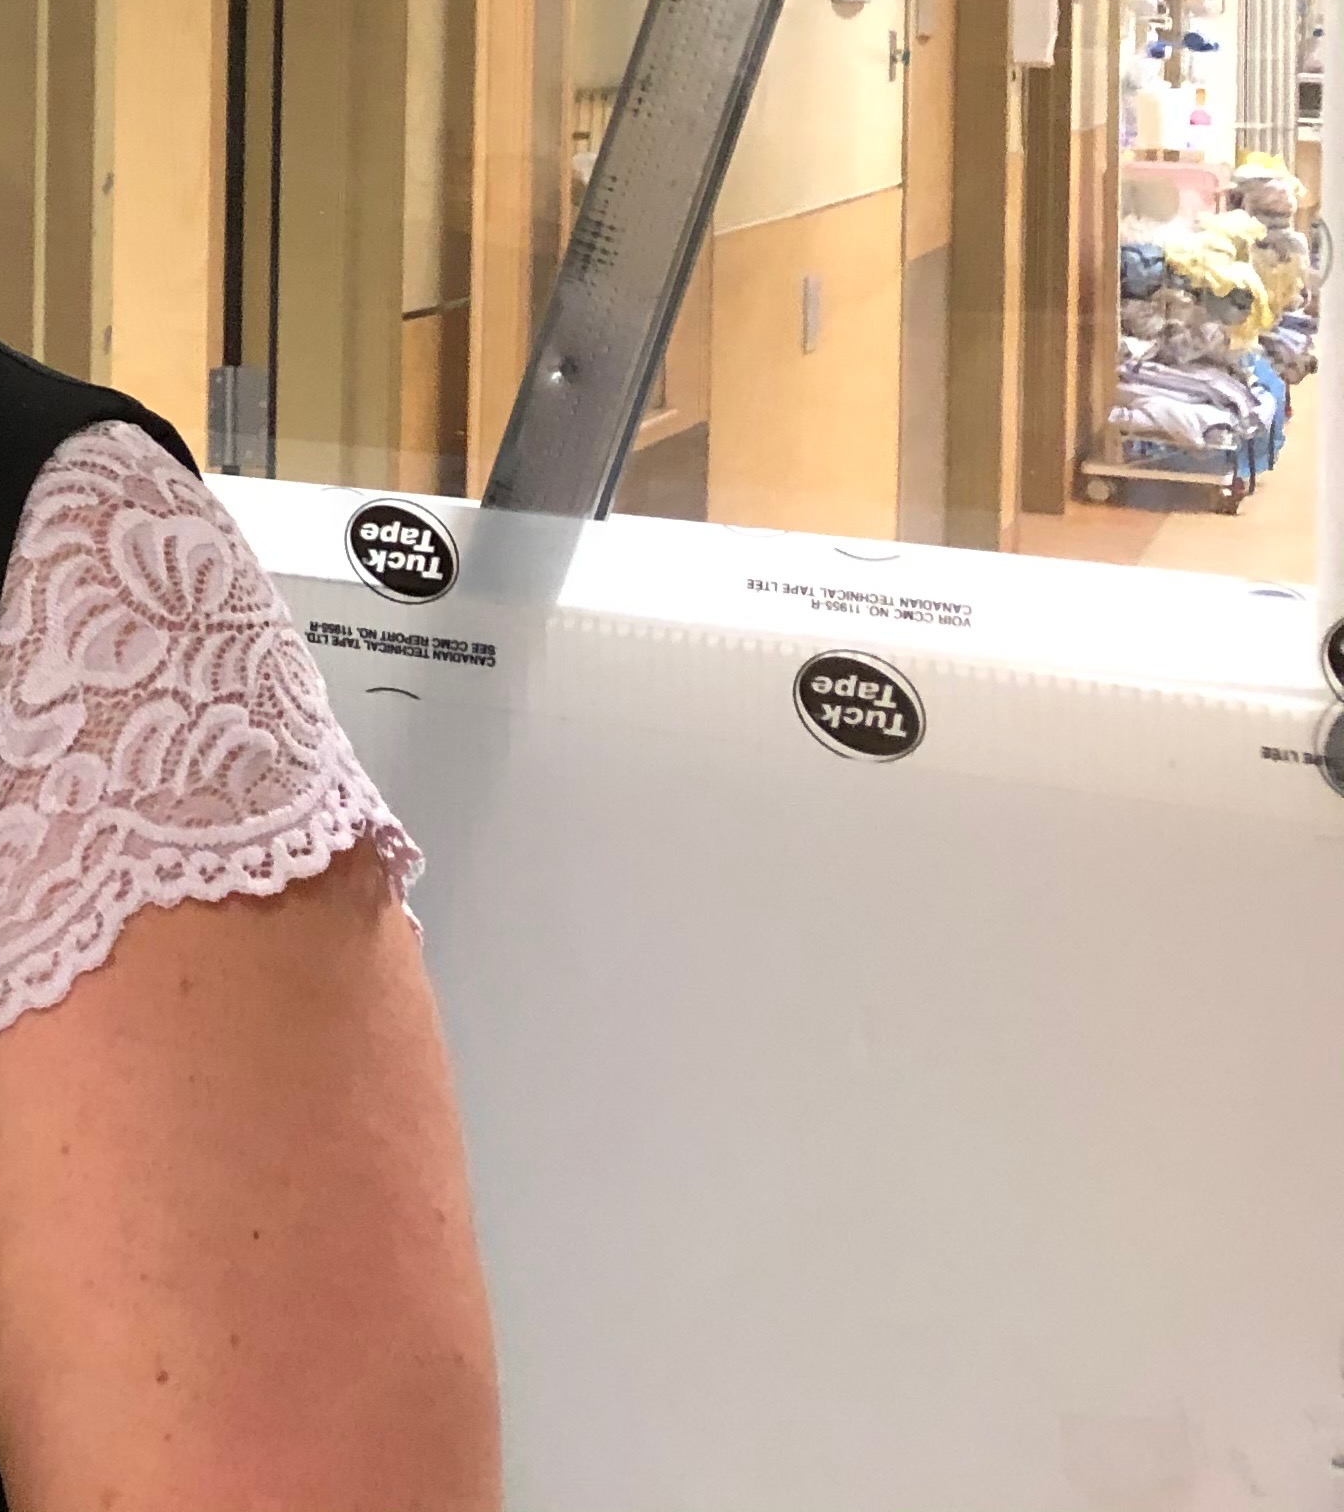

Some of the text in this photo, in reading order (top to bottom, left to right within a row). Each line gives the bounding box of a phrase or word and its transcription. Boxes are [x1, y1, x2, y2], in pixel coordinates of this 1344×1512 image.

[359, 521, 435, 553] Tape
[363, 548, 444, 581] Tuck
[782, 582, 814, 597] TAPE
[820, 587, 895, 606] TECHNICAL
[900, 597, 973, 616] CANADIAN
[894, 610, 934, 624] CCMC
[939, 615, 972, 628] VOIR
[332, 635, 361, 650] TAPE
[381, 630, 430, 647] REPORT
[432, 637, 468, 652] CCMC
[366, 641, 430, 659] TECHNICAL
[471, 642, 496, 656] SEE
[432, 652, 496, 668] CANADIAN
[811, 674, 897, 709] Tape
[821, 703, 907, 738] Tuck
